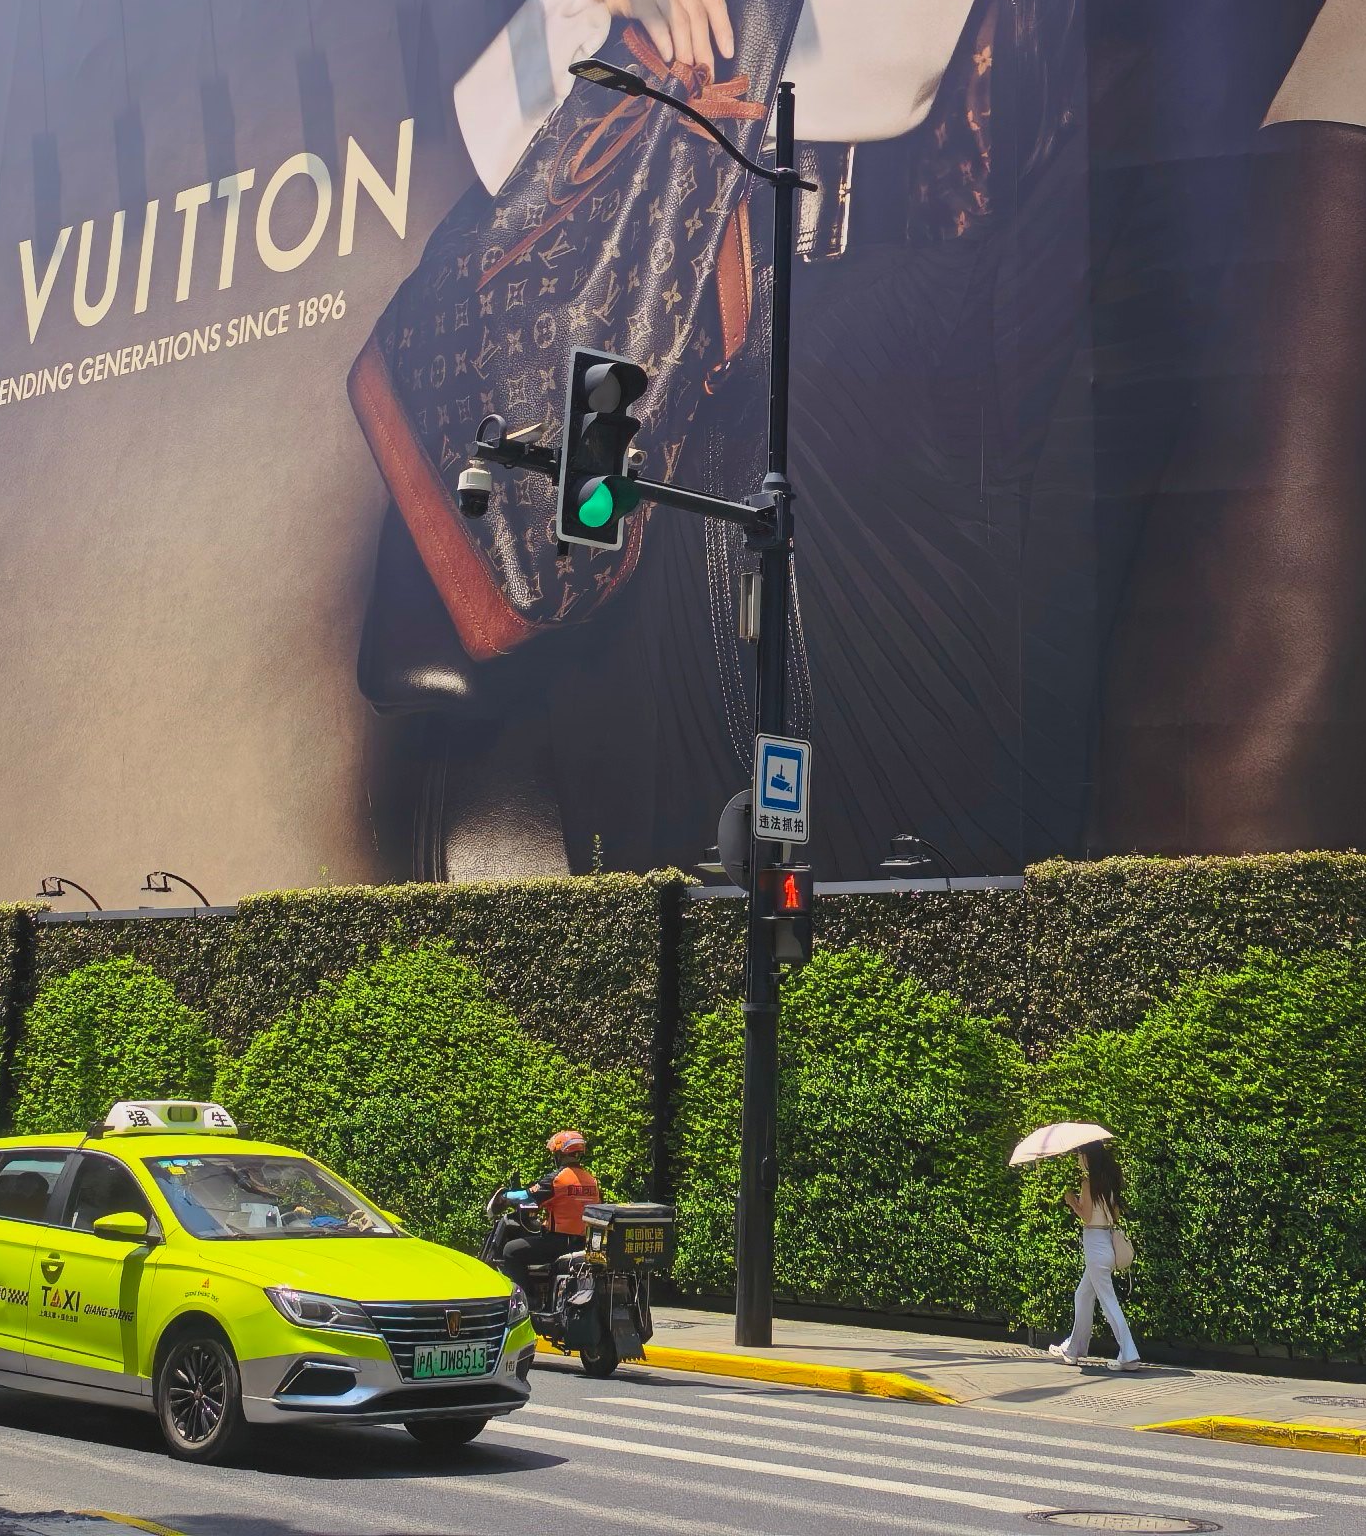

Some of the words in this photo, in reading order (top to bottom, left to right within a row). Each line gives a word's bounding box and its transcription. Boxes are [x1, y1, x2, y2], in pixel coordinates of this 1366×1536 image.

[20, 118, 415, 344] VUITTON
[78, 324, 222, 385] GENERATIONS
[226, 304, 290, 348] SINCE
[298, 290, 346, 329] 1896
[758, 814, 804, 834] 违法抓拍
[41, 1285, 81, 1313] TAXI
[83, 1304, 108, 1317] QIANG
[109, 1308, 135, 1322] SHENG
